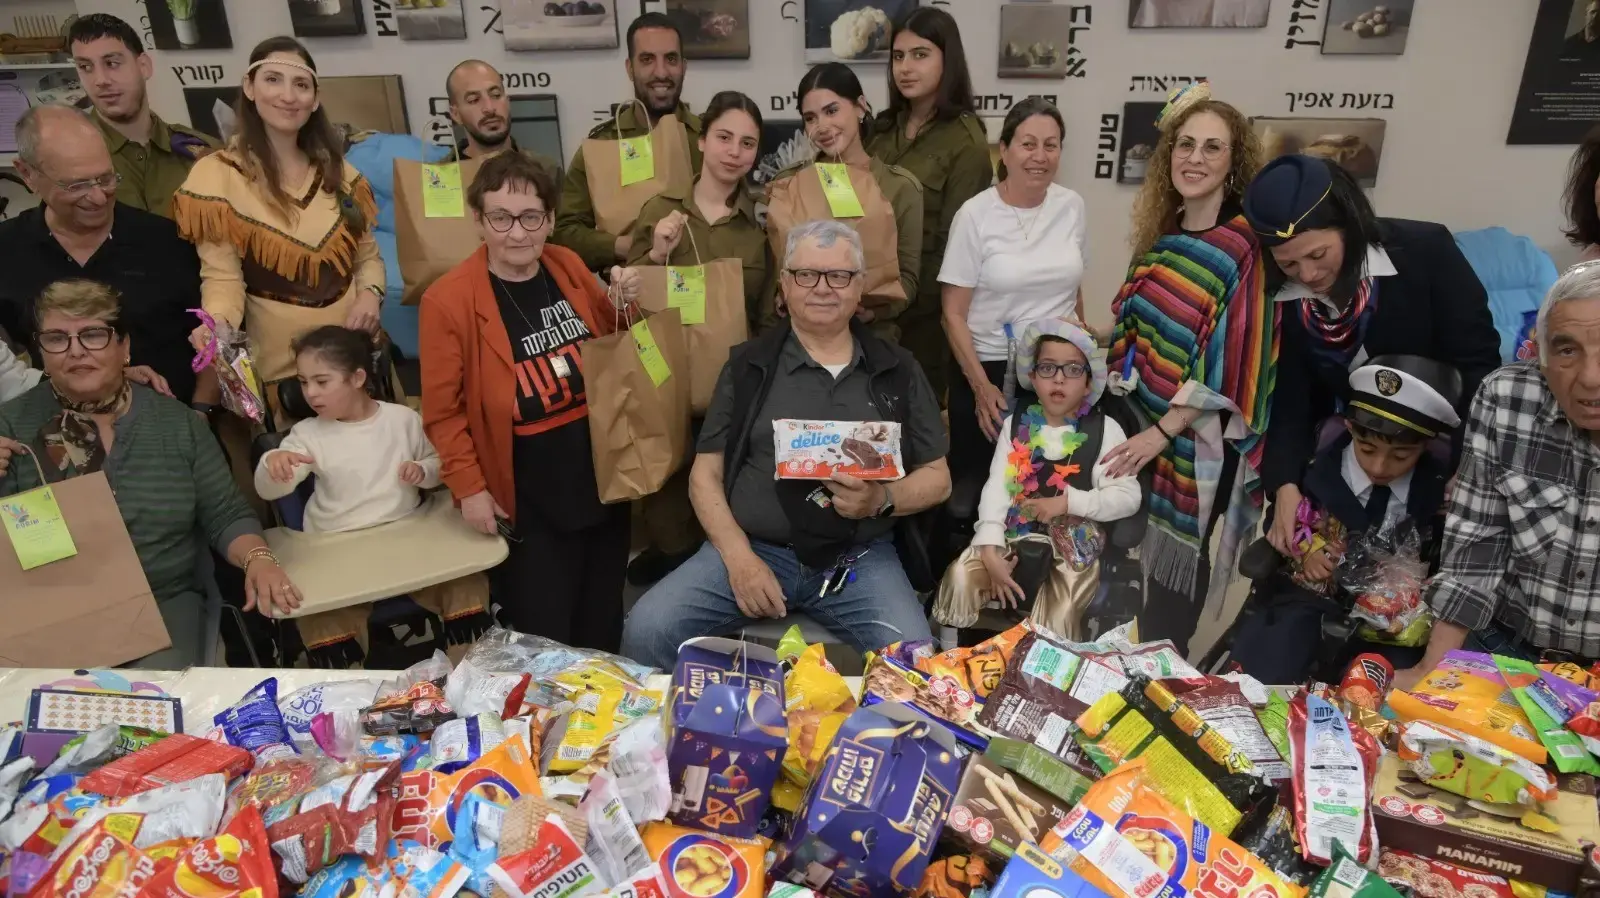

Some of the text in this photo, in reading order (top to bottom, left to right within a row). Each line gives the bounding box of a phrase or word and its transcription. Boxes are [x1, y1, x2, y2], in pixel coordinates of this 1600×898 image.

[171, 64, 225, 86] קוורץ
[1285, 92, 1395, 112] בזעת אפיך
[521, 326, 565, 357] הביתה
[803, 423, 825, 431] Kinder
[847, 756, 875, 803] פורים
[1436, 845, 1523, 875] MANAMIM
